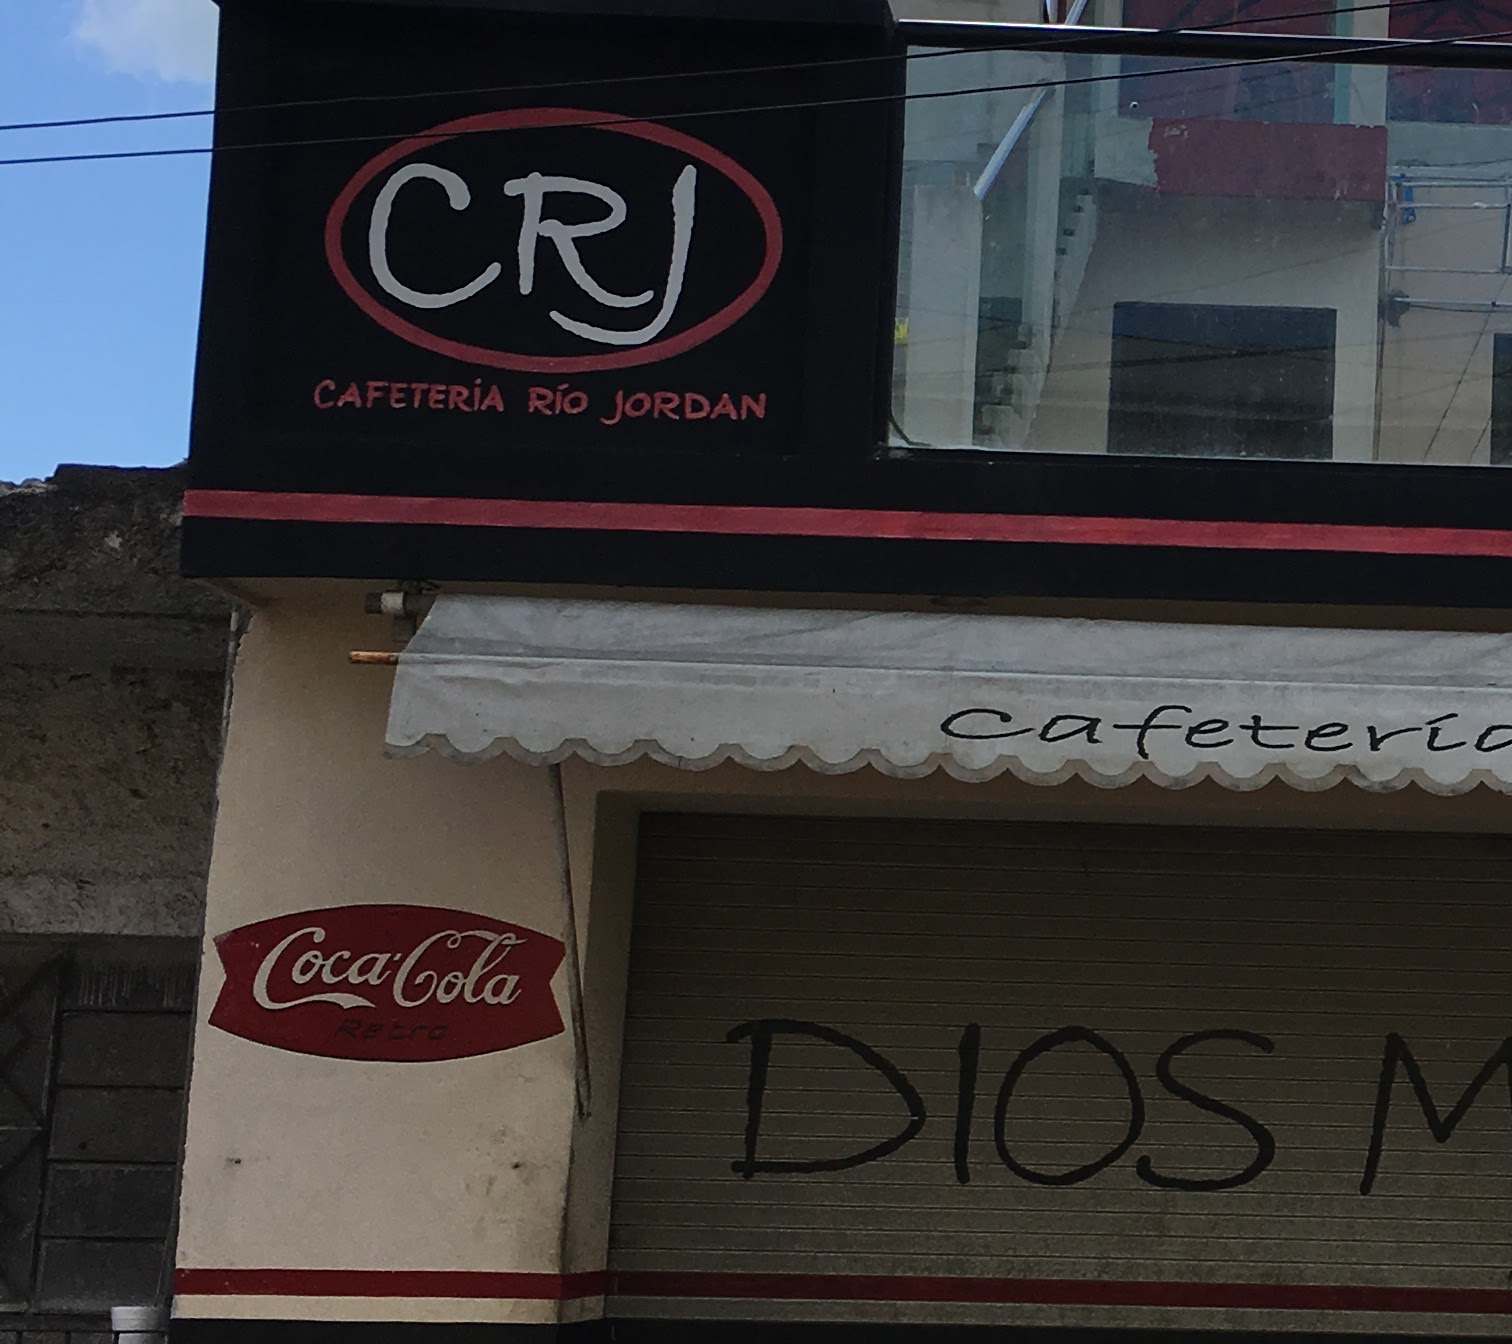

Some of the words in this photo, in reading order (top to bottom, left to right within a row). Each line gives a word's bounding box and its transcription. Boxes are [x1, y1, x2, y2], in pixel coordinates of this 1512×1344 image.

[367, 162, 697, 346] CRJ
[313, 378, 505, 413] CAFETERÍA
[527, 383, 589, 416] RÍO
[600, 390, 767, 425] JORDAN
[252, 926, 528, 1010] Coca-Cola
[334, 1018, 449, 1041] Retro
[725, 1018, 1276, 1192] DIOS
